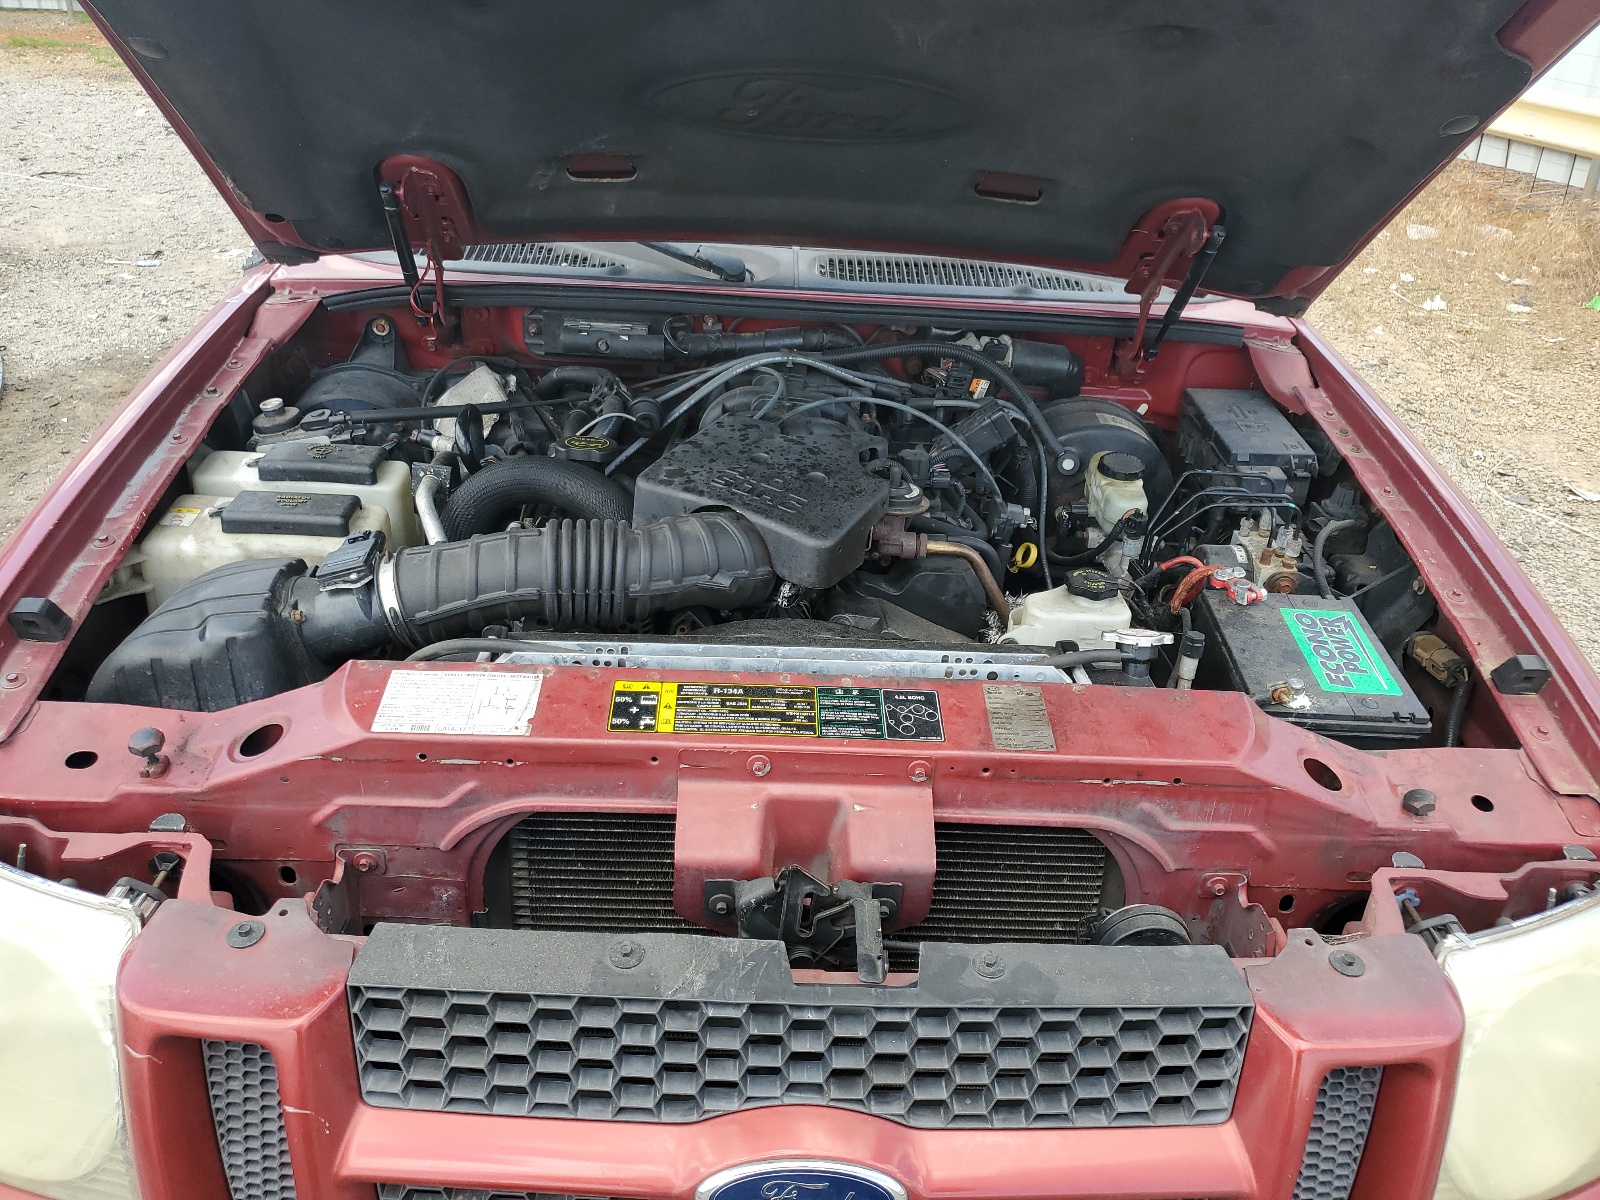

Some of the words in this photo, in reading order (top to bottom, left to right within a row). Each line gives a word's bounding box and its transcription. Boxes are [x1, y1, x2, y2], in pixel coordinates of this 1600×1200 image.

[1293, 611, 1357, 690] ECONO
[1316, 613, 1371, 676] POWER
[713, 687, 744, 696] R-134A
